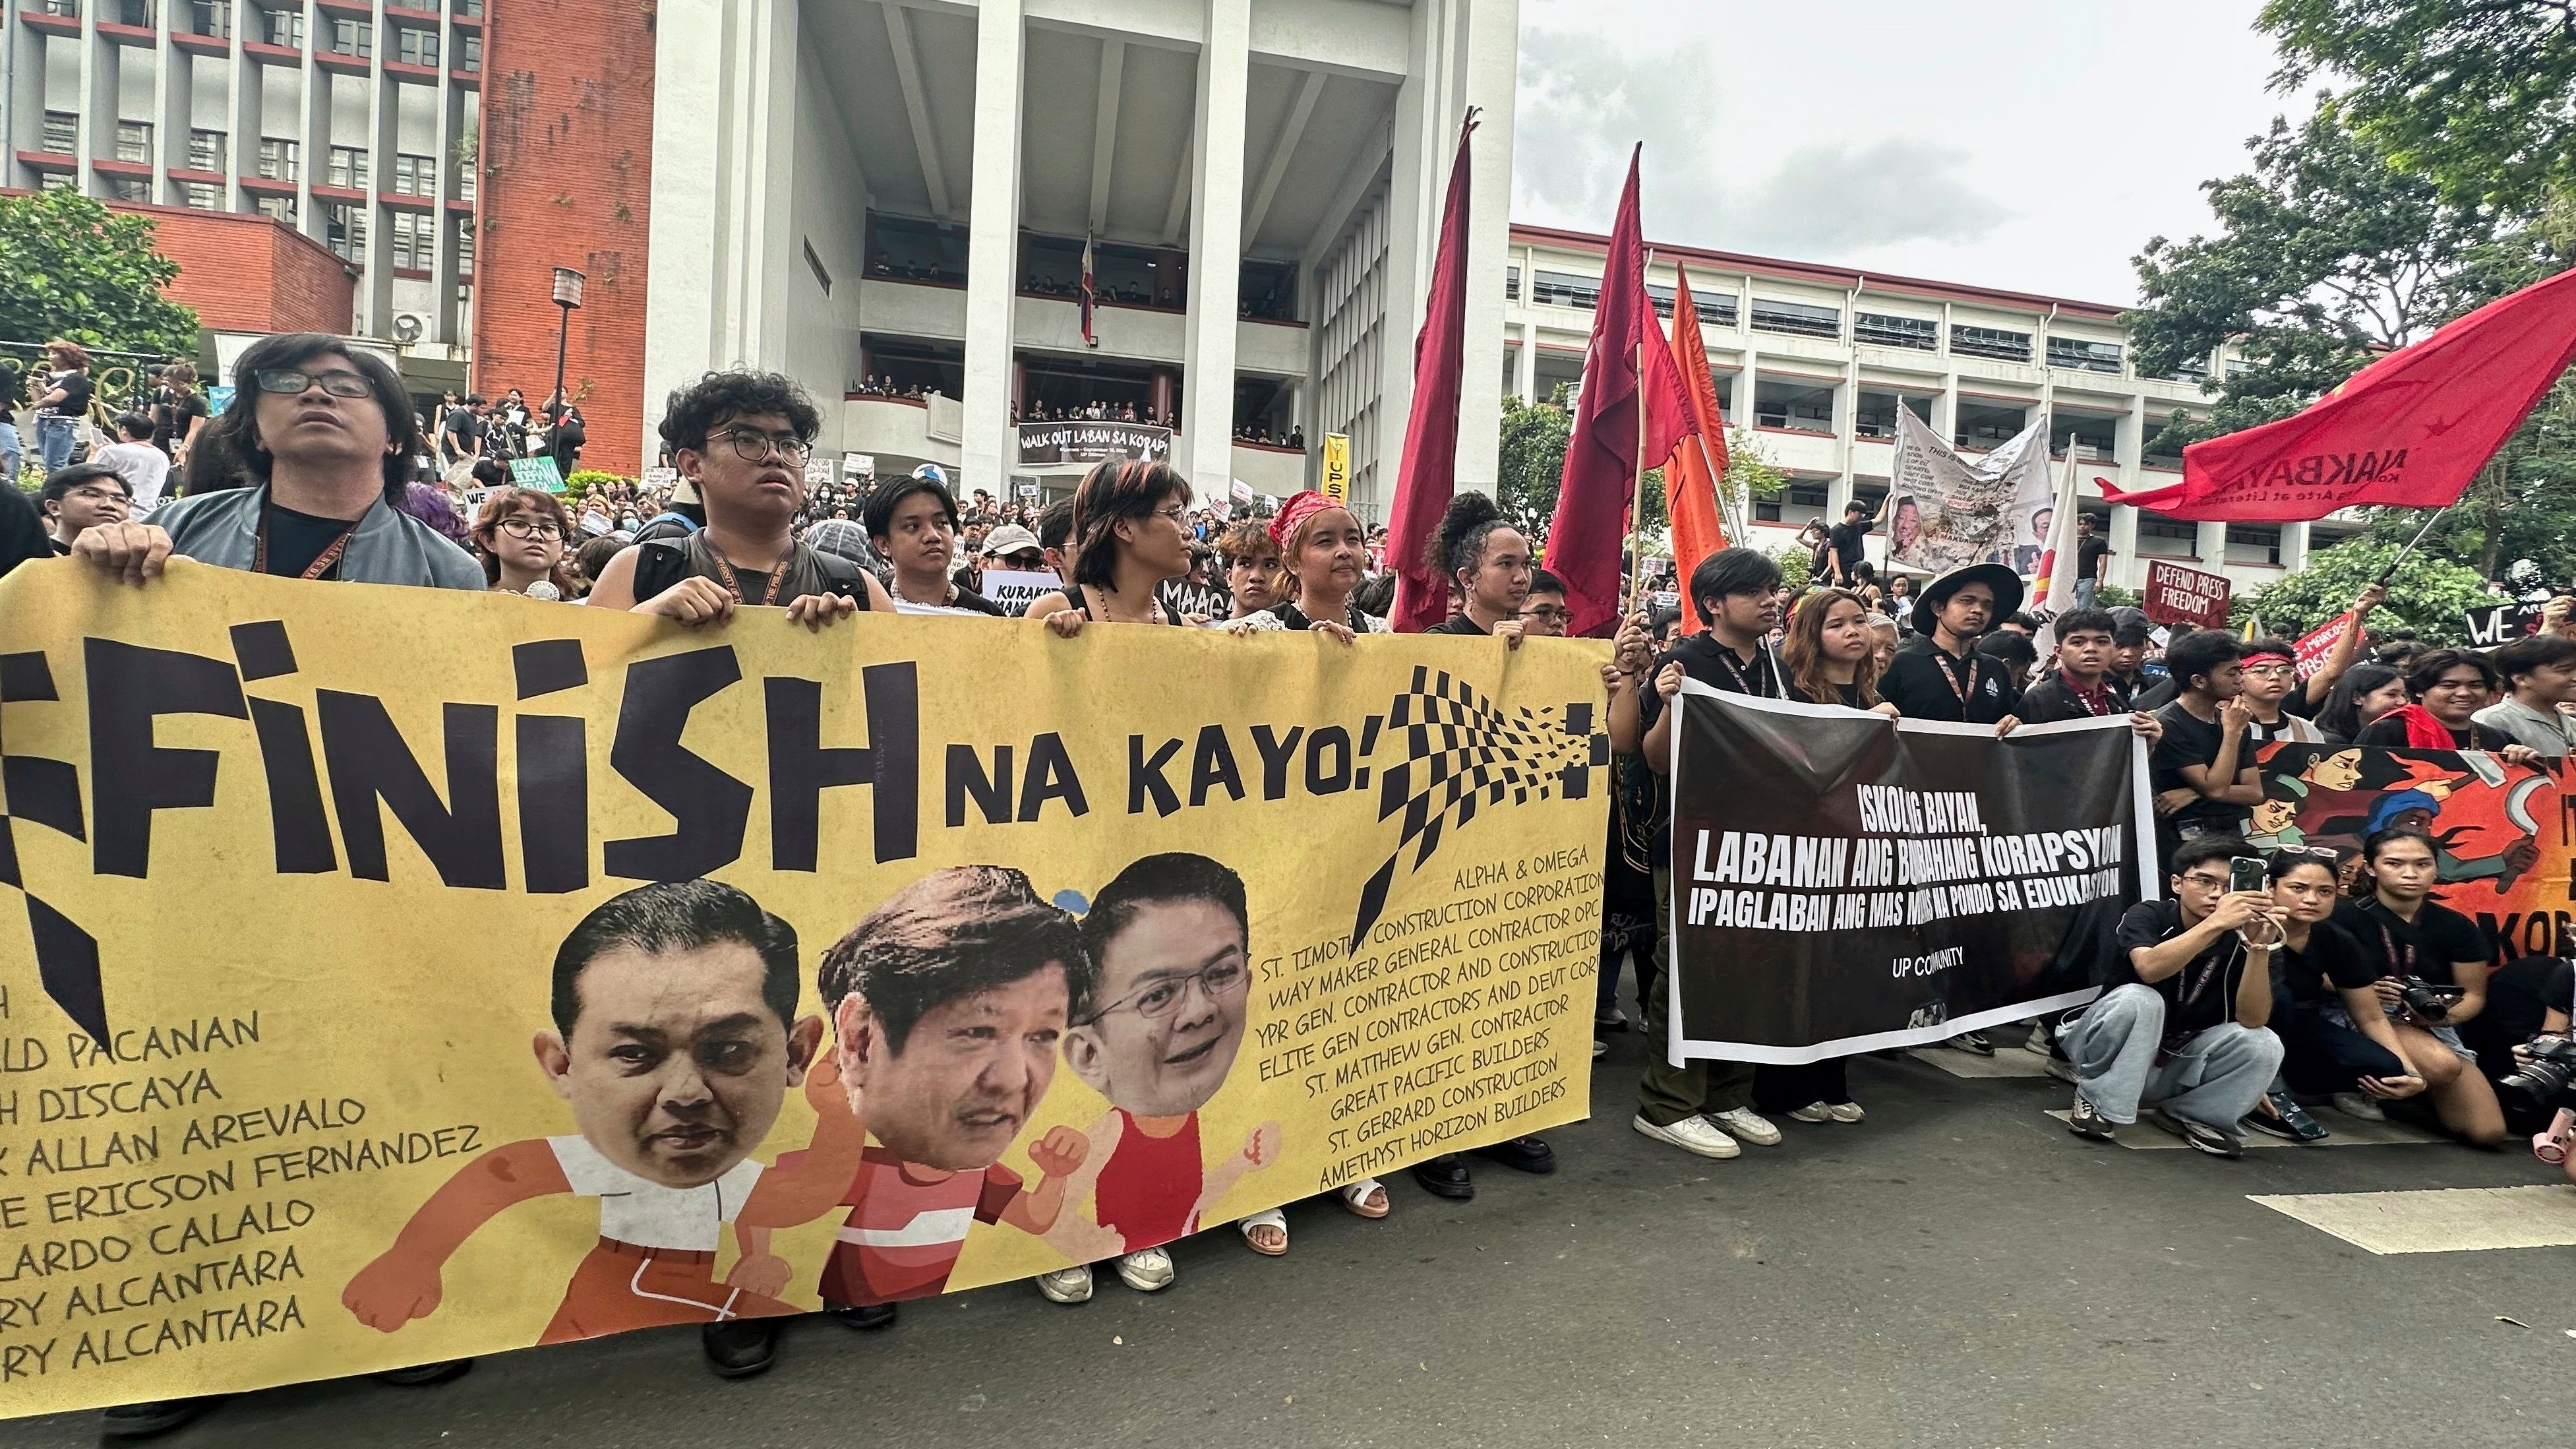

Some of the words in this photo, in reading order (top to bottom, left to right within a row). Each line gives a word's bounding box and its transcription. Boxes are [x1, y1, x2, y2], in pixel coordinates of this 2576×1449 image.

[1021, 433, 1050, 448] WALK
[1051, 429, 1072, 445] OUT
[1074, 429, 1110, 444] LABAN
[1112, 430, 1127, 445] SA
[1929, 447, 1948, 458] THIS
[467, 493, 486, 505] WE
[2155, 565, 2195, 591] DEFEND
[2196, 574, 2225, 601] PRESS
[2160, 586, 2209, 615] FREEDOM
[2293, 621, 2347, 660] S-MARCOS
[2466, 605, 2516, 645] WE
[946, 731, 1089, 828] NA
[1127, 715, 1384, 818] KAYO!
[1923, 791, 1987, 836] BAYAN,
[1454, 860, 1509, 892] ALPHA
[1516, 859, 1528, 880] &
[1534, 844, 1589, 875] OMEGA
[1693, 829, 1848, 888] LABANAN
[1850, 838, 1893, 887] ANG
[1979, 824, 2122, 877] KORAPSYON
[1261, 958, 1284, 983] ST.
[1373, 896, 1497, 944] CONSTRUCTION
[1504, 867, 1605, 911] CORPORATION
[1687, 887, 1831, 932] IPAGLABAN
[1832, 892, 1867, 931] ANG
[1868, 892, 1903, 927] MAS
[1932, 886, 1950, 919] NA
[1949, 881, 1994, 918] PONDO
[1995, 879, 2023, 912] SA
[2022, 867, 2120, 909] EDUKASYON
[1269, 980, 1313, 1012] WAY
[1319, 957, 1379, 995] MAKER
[1385, 941, 1463, 975] GENERAL
[1468, 908, 1571, 950] CONTRACTOR
[1574, 898, 1600, 923] OPC
[1892, 957, 1911, 979] UP
[1256, 1019, 1288, 1049] YPR
[1296, 1008, 1337, 1037] GEN.
[1344, 970, 1451, 1017] CONTRACTOR
[1457, 958, 1492, 987] AND
[1259, 1043, 1315, 1082] ELITE
[1322, 1026, 1359, 1060] GEN
[1366, 989, 1482, 1050] CONTRACTORS
[1488, 979, 1522, 1007] AND
[1528, 967, 1567, 995] DEVT
[1305, 1073, 1329, 1099] ST.
[1336, 1041, 1422, 1088] MATTHEW
[1427, 1026, 1464, 1055] GEN.
[1471, 994, 1569, 1042] CONTRACTOR
[1331, 1082, 1389, 1122] GREAT
[1394, 1055, 1465, 1097] PACIFIC
[1472, 1028, 1551, 1070] BUILDERS
[39, 1068, 222, 1123] DISCAYA
[1328, 1130, 1351, 1154] ST.
[1357, 1097, 1436, 1142] GERRARD
[1442, 1052, 1559, 1108] CONSTRUCTION
[28, 1125, 159, 1177] ALLAN
[182, 1097, 367, 1156] AREVALO
[1319, 1136, 1406, 1192] AMETHYST
[1411, 1109, 1488, 1153] HORIZON
[1494, 1076, 1569, 1124] BUILDERS
[46, 1161, 235, 1223] ERICSON
[254, 1125, 483, 1188] FERNANDEZ
[149, 1199, 316, 1256] CALALO
[66, 1245, 305, 1321] ALCANTARA
[72, 1295, 307, 1370] ALCANTARA
